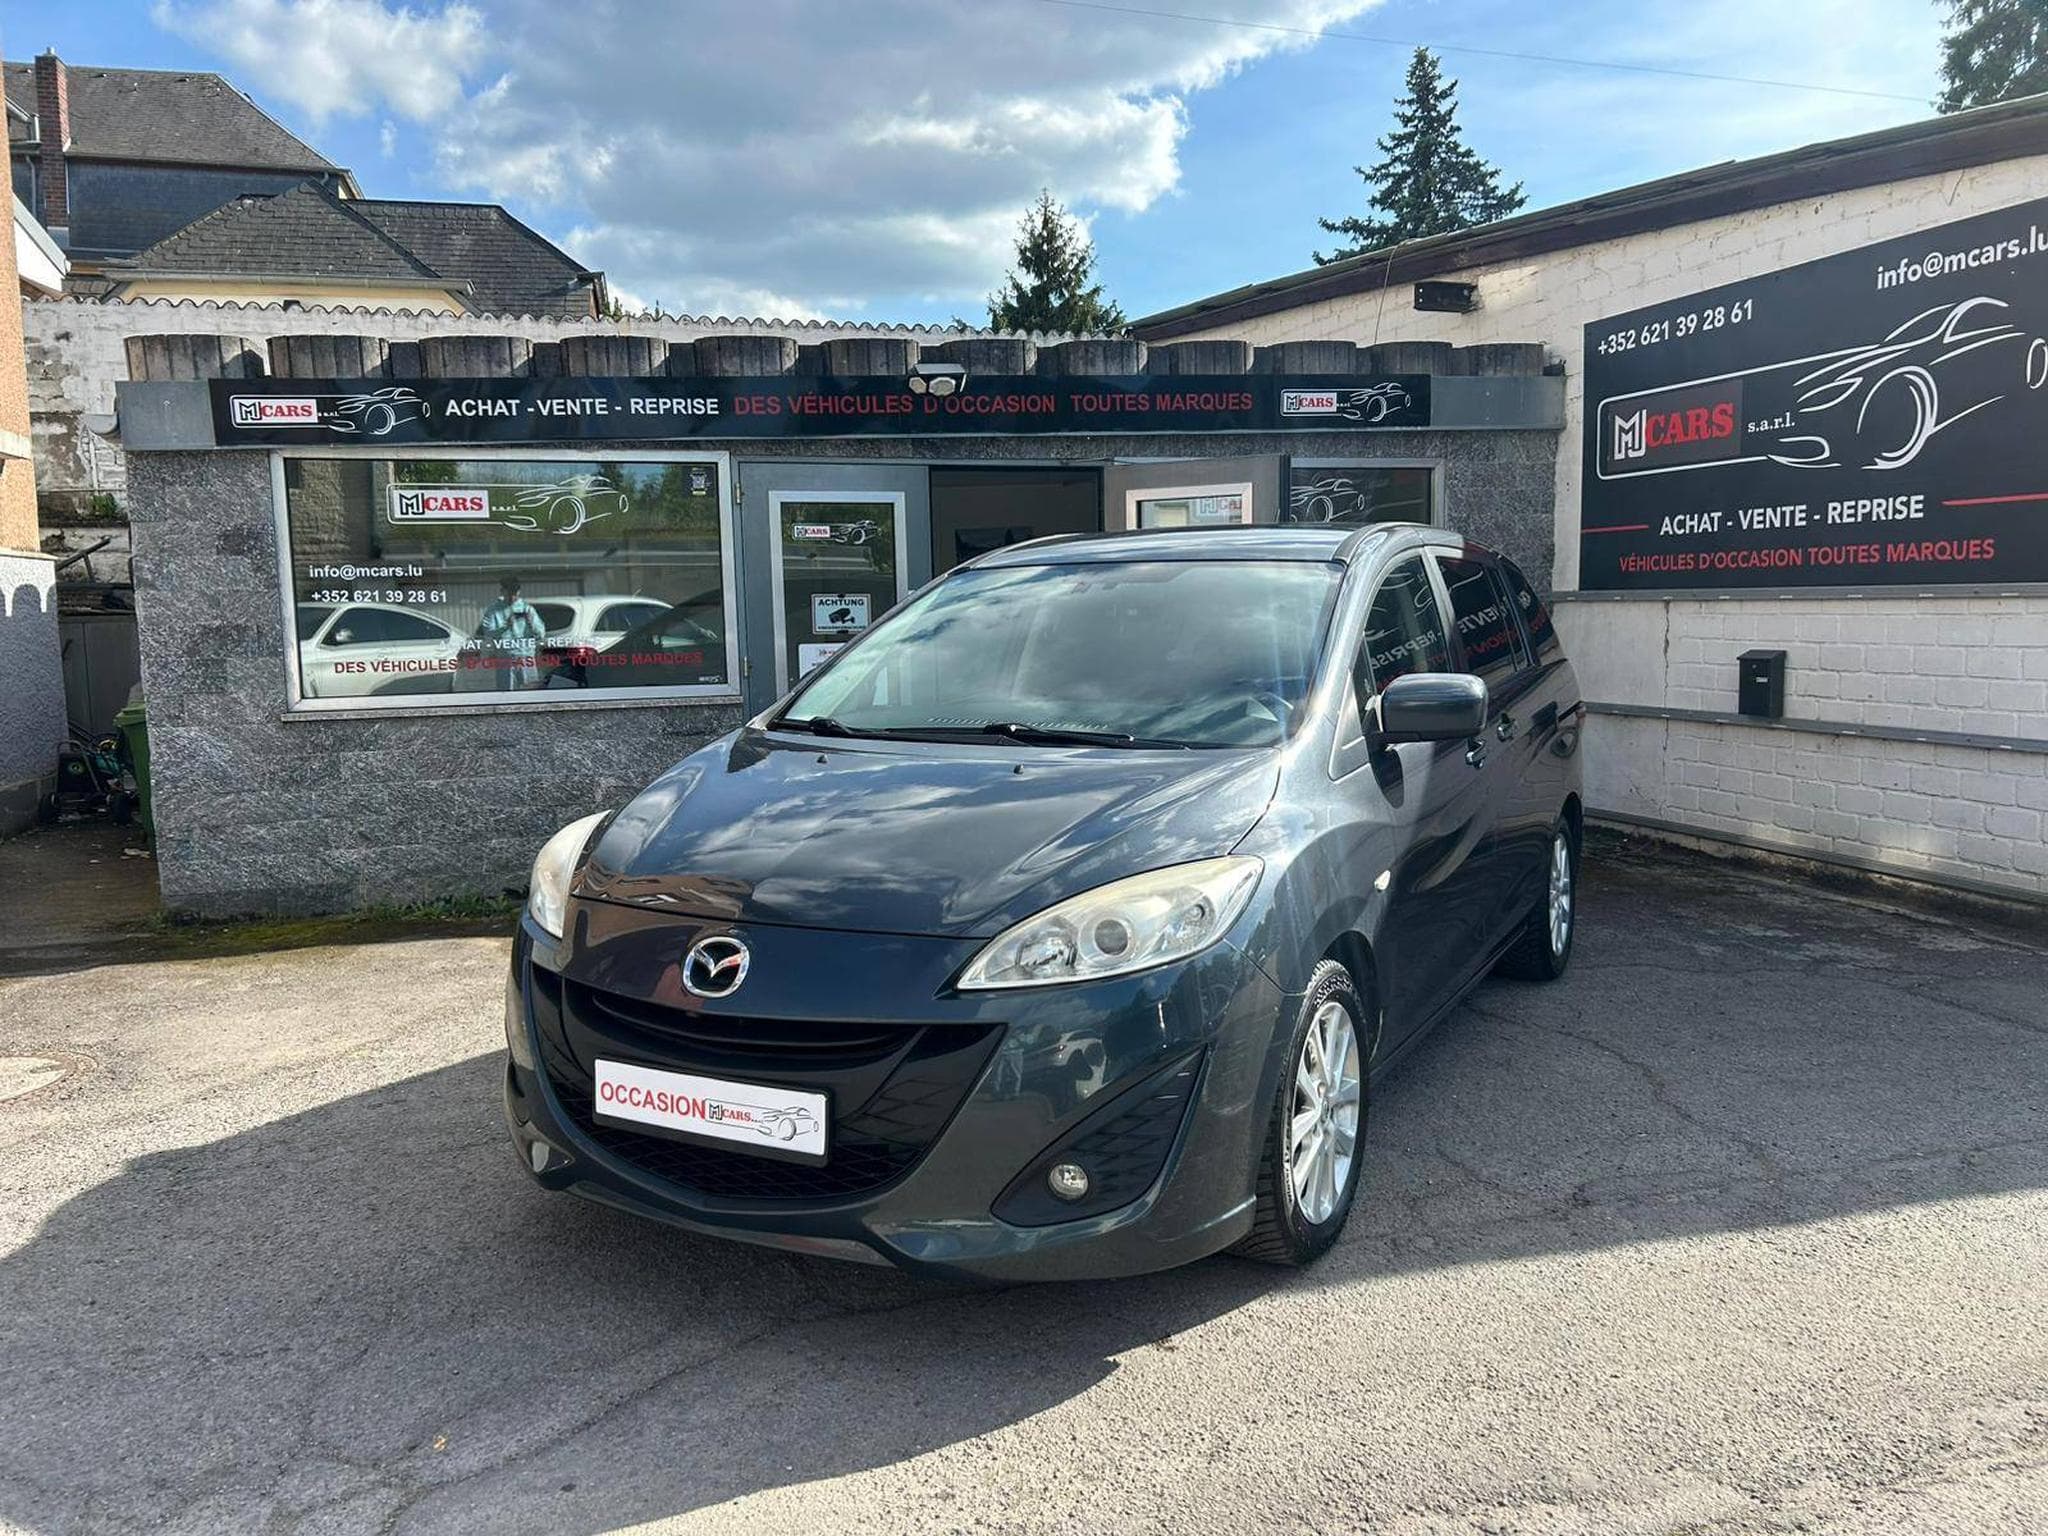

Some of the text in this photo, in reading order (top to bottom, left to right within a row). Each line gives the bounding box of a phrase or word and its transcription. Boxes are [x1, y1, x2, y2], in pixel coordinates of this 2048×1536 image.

[1877, 225, 2048, 290] info@mcars.lu
[1598, 298, 1753, 355] +352 621 39 28 61
[445, 398, 521, 416] ACHAT
[537, 398, 609, 416] VENTE
[629, 397, 719, 416] REPRISE
[734, 396, 782, 415] DES
[788, 391, 914, 415] VÉHICULES
[1070, 392, 1253, 412] TOUTES MARQUES
[1747, 412, 1795, 433] s.a.r.l.
[1660, 511, 1722, 536] ACHAT
[1739, 504, 1807, 531] VENTE
[1827, 494, 1924, 525] REPRISE
[1619, 537, 1995, 573] VÉHICULES D'OCCASION TOUTES MARQUES
[309, 564, 422, 580] info@mcars.lu
[311, 590, 447, 603] +352 621 39 28 61
[818, 598, 864, 607] ACHTUNG
[493, 638, 536, 649] VENTE
[334, 661, 367, 673] DES
[370, 658, 459, 673] VÉHICULES
[600, 1081, 706, 1120] OCCASION
